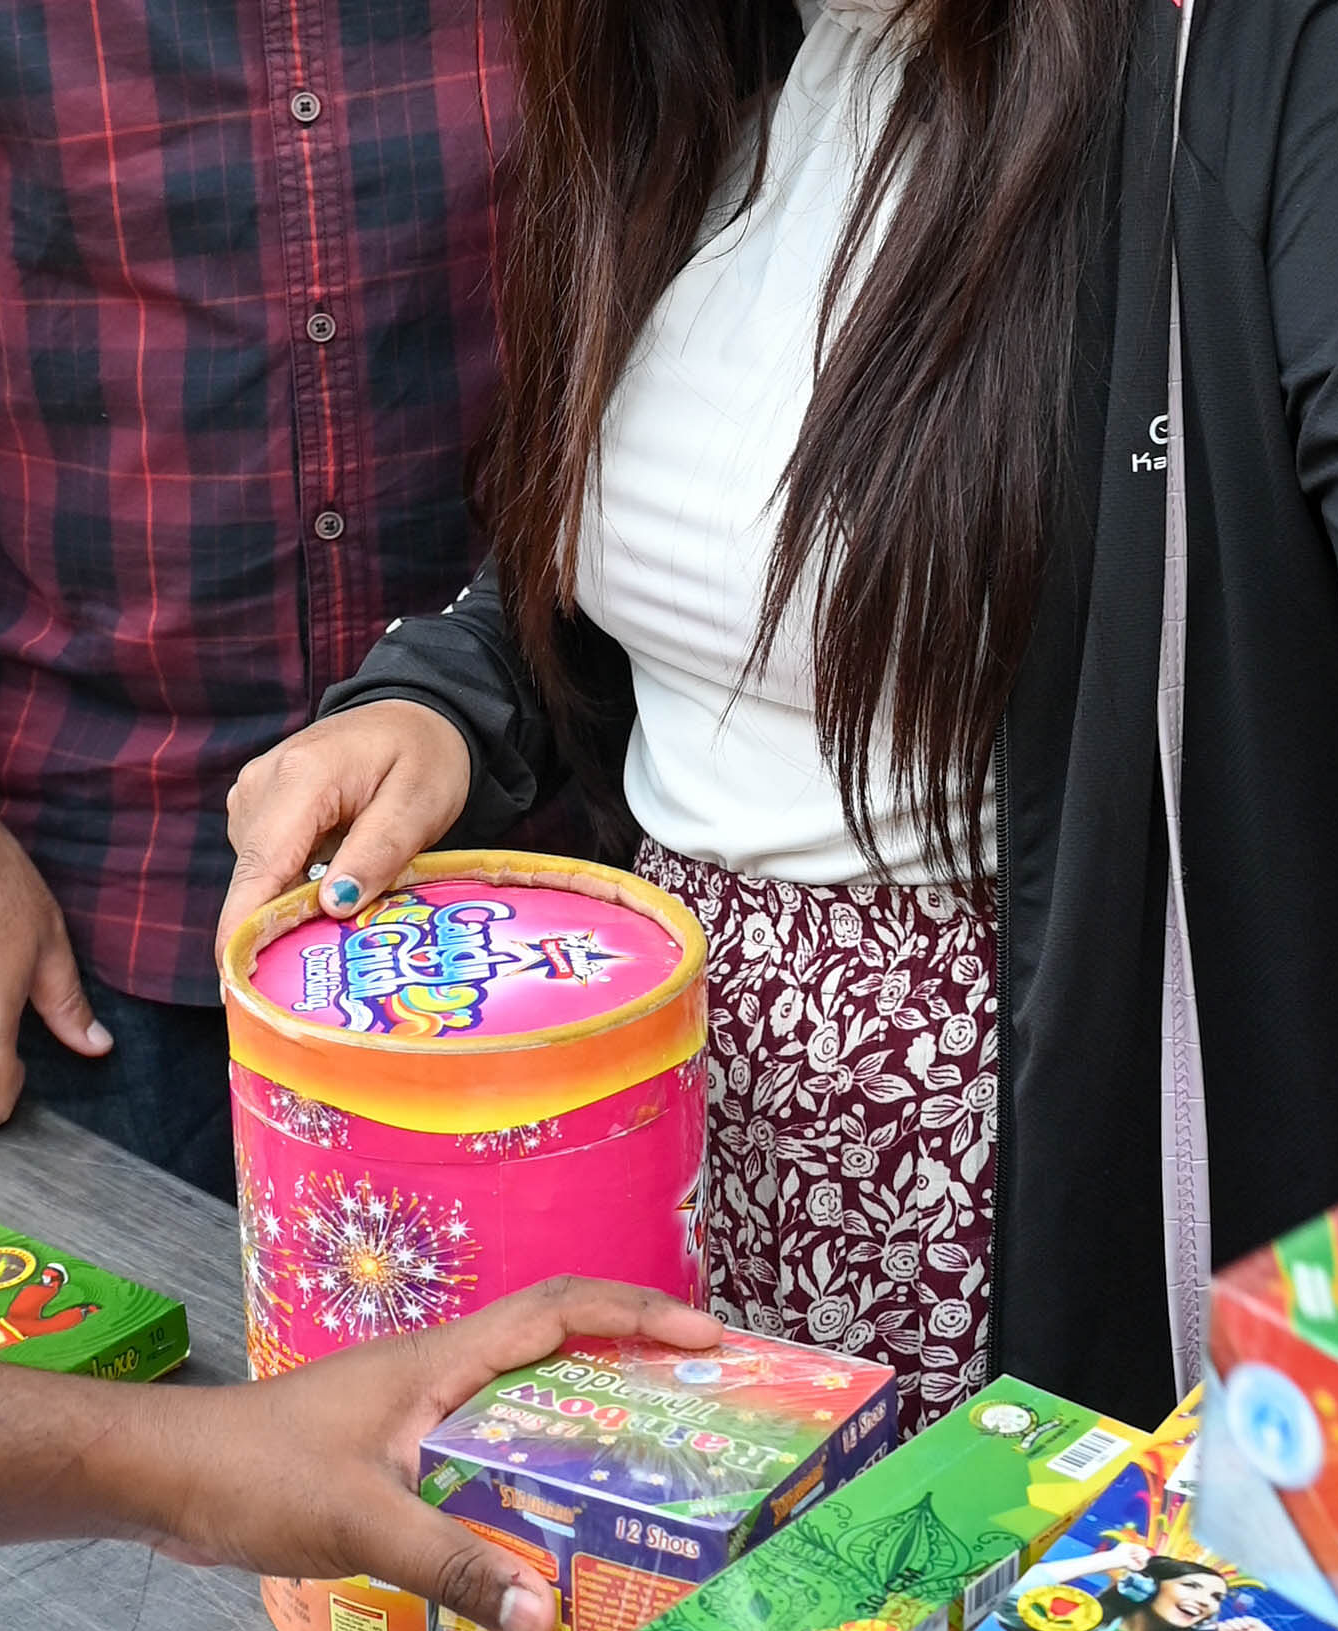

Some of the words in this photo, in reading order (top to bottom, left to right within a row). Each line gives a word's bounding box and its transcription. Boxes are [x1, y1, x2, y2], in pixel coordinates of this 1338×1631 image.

[294, 943, 340, 1011] Crackling
[344, 922, 416, 1000] Crush
[88, 1345, 141, 1380] luxe
[497, 1382, 780, 1473] Rainbow
[615, 1516, 642, 1545] 12
[646, 1525, 700, 1560] Shots
